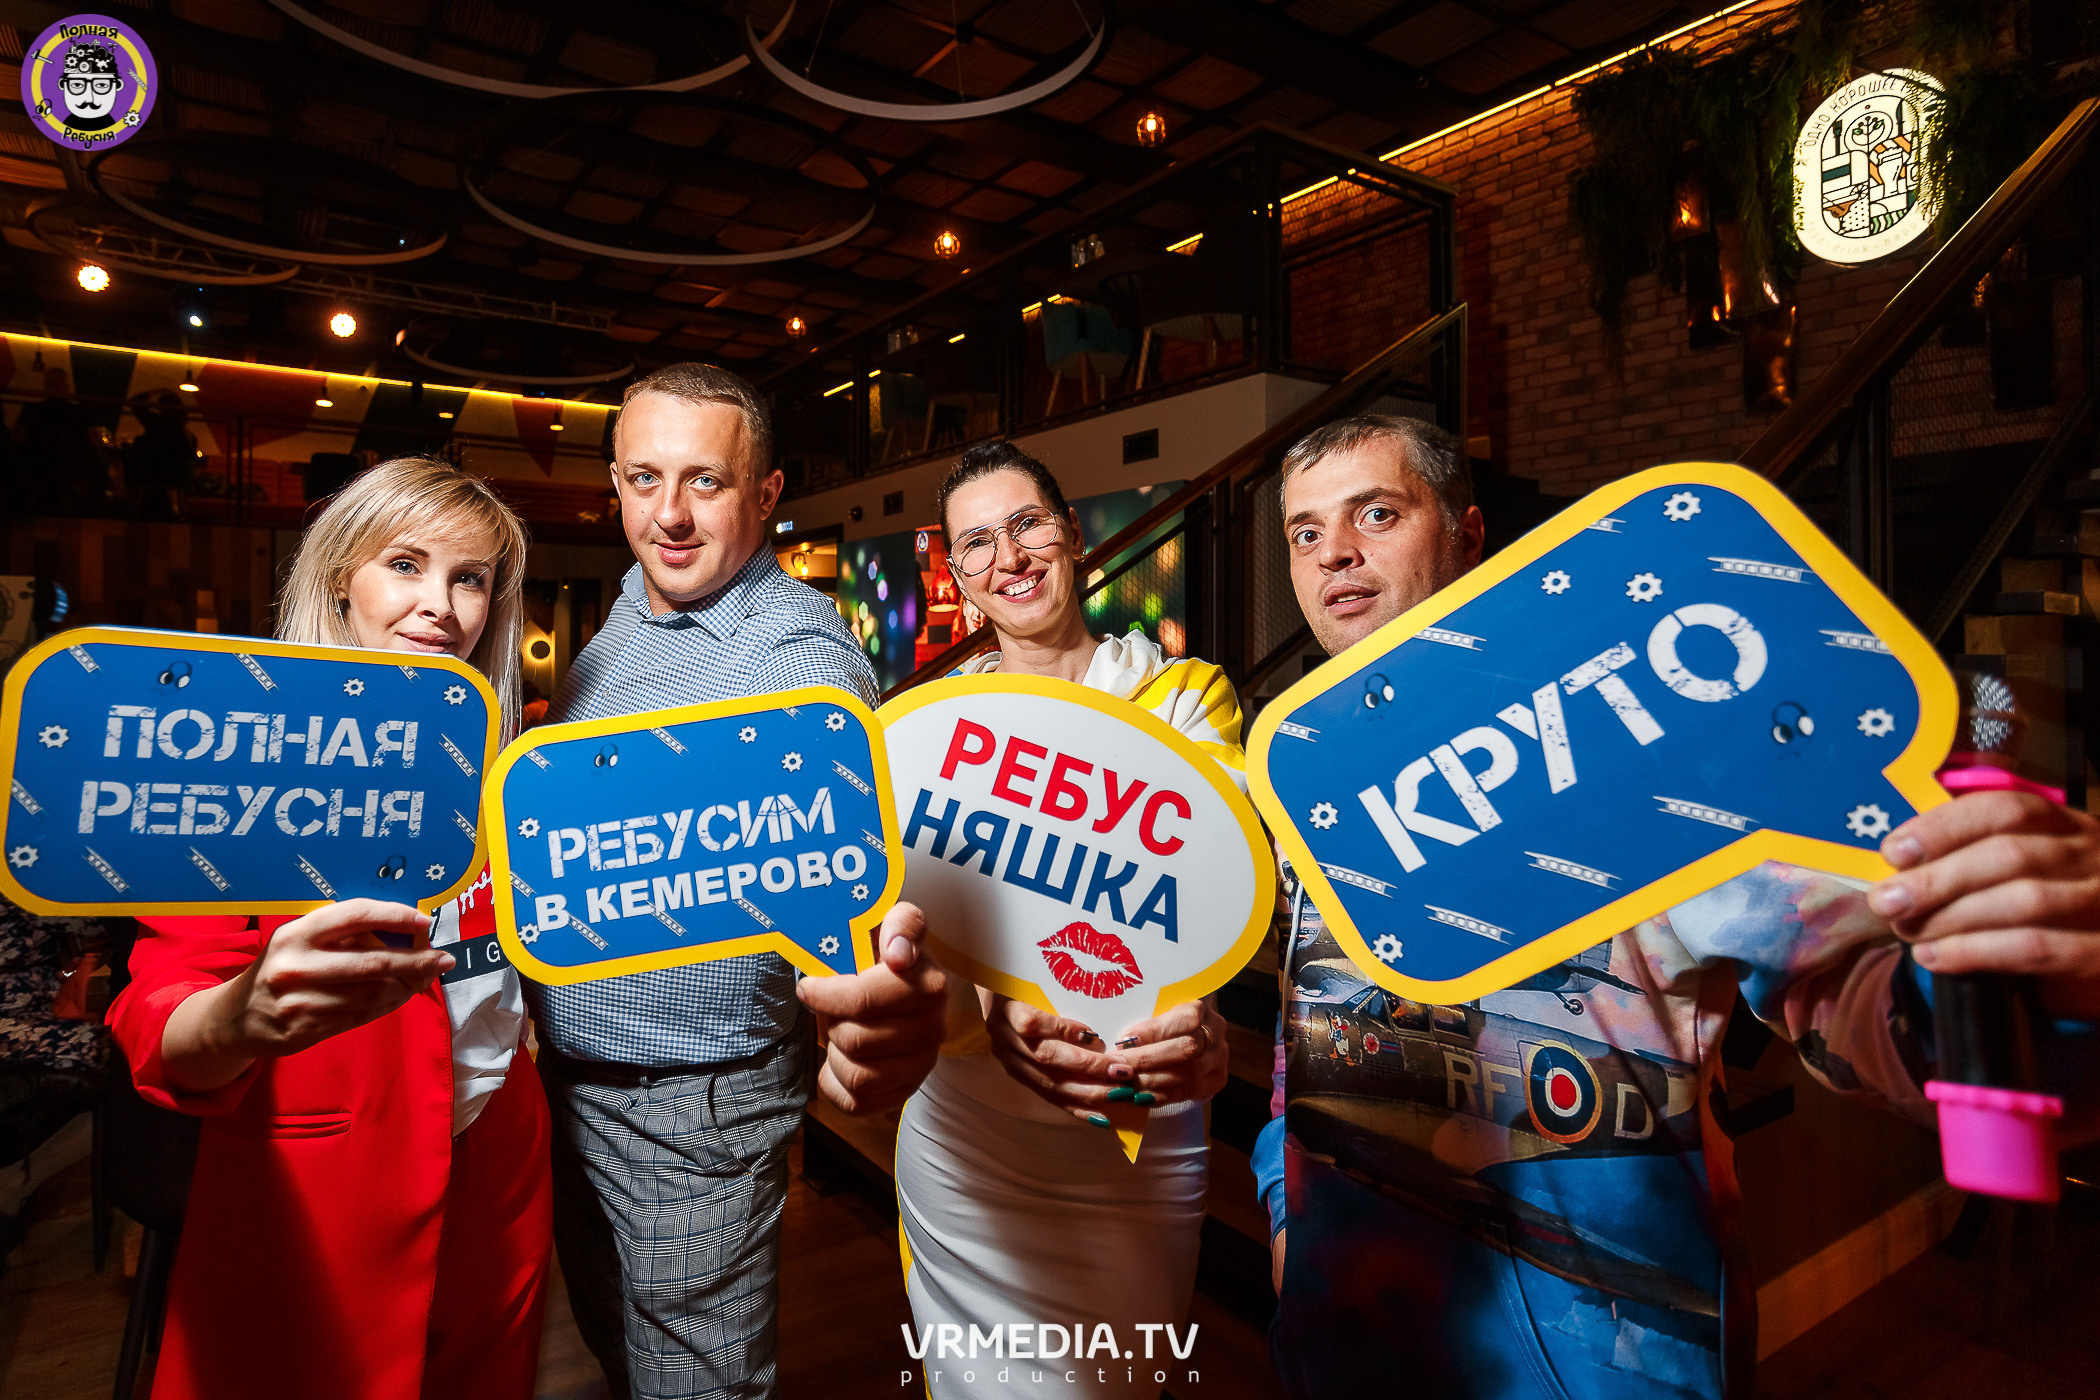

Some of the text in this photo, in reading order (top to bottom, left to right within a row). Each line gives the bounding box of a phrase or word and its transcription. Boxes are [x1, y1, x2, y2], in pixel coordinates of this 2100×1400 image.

[1803, 114, 1831, 147] ОДНО
[102, 704, 419, 769] ПОЛНАЯ
[1357, 602, 1769, 873] КРУТО
[77, 780, 425, 839] РЕБУСНЯ
[939, 717, 1192, 857] РЕБУС
[547, 787, 836, 879] РЕБУСИМ
[902, 788, 1179, 944] НЯШКА
[535, 844, 868, 932] В КЕМЕРОВО
[1443, 1052, 1522, 1118] RF
